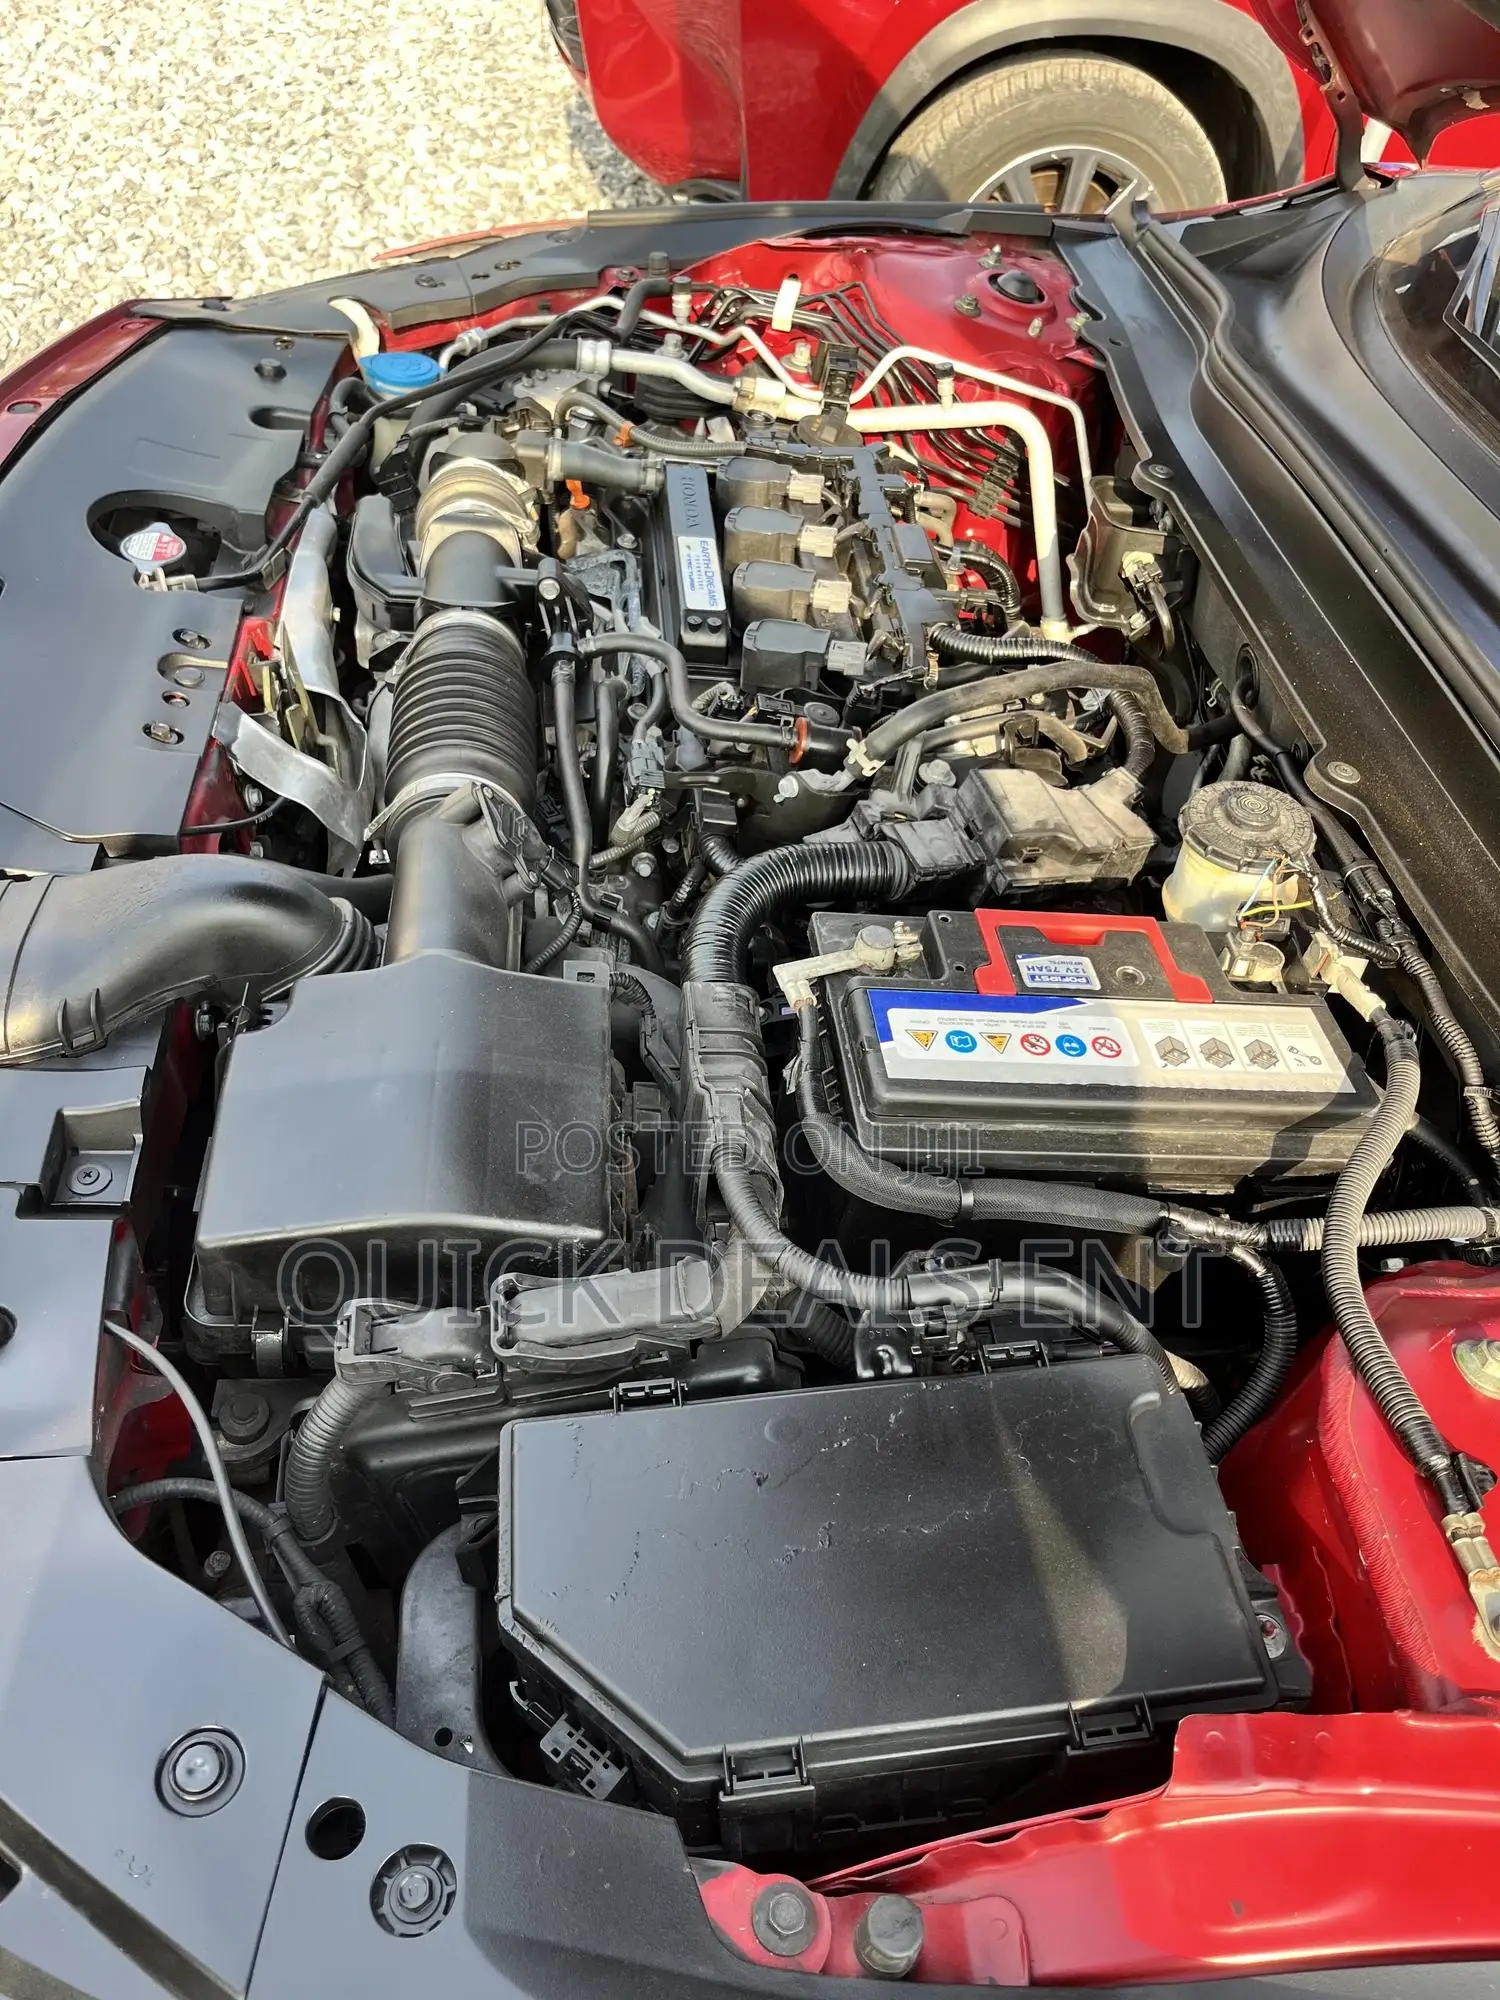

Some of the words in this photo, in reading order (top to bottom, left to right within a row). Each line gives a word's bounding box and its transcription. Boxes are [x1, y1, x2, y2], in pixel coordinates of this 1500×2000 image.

[700, 540, 712, 570] EARTH
[705, 570, 719, 607] DREAMS
[1026, 965, 1060, 973] 75AH
[1065, 966, 1087, 974] 12V
